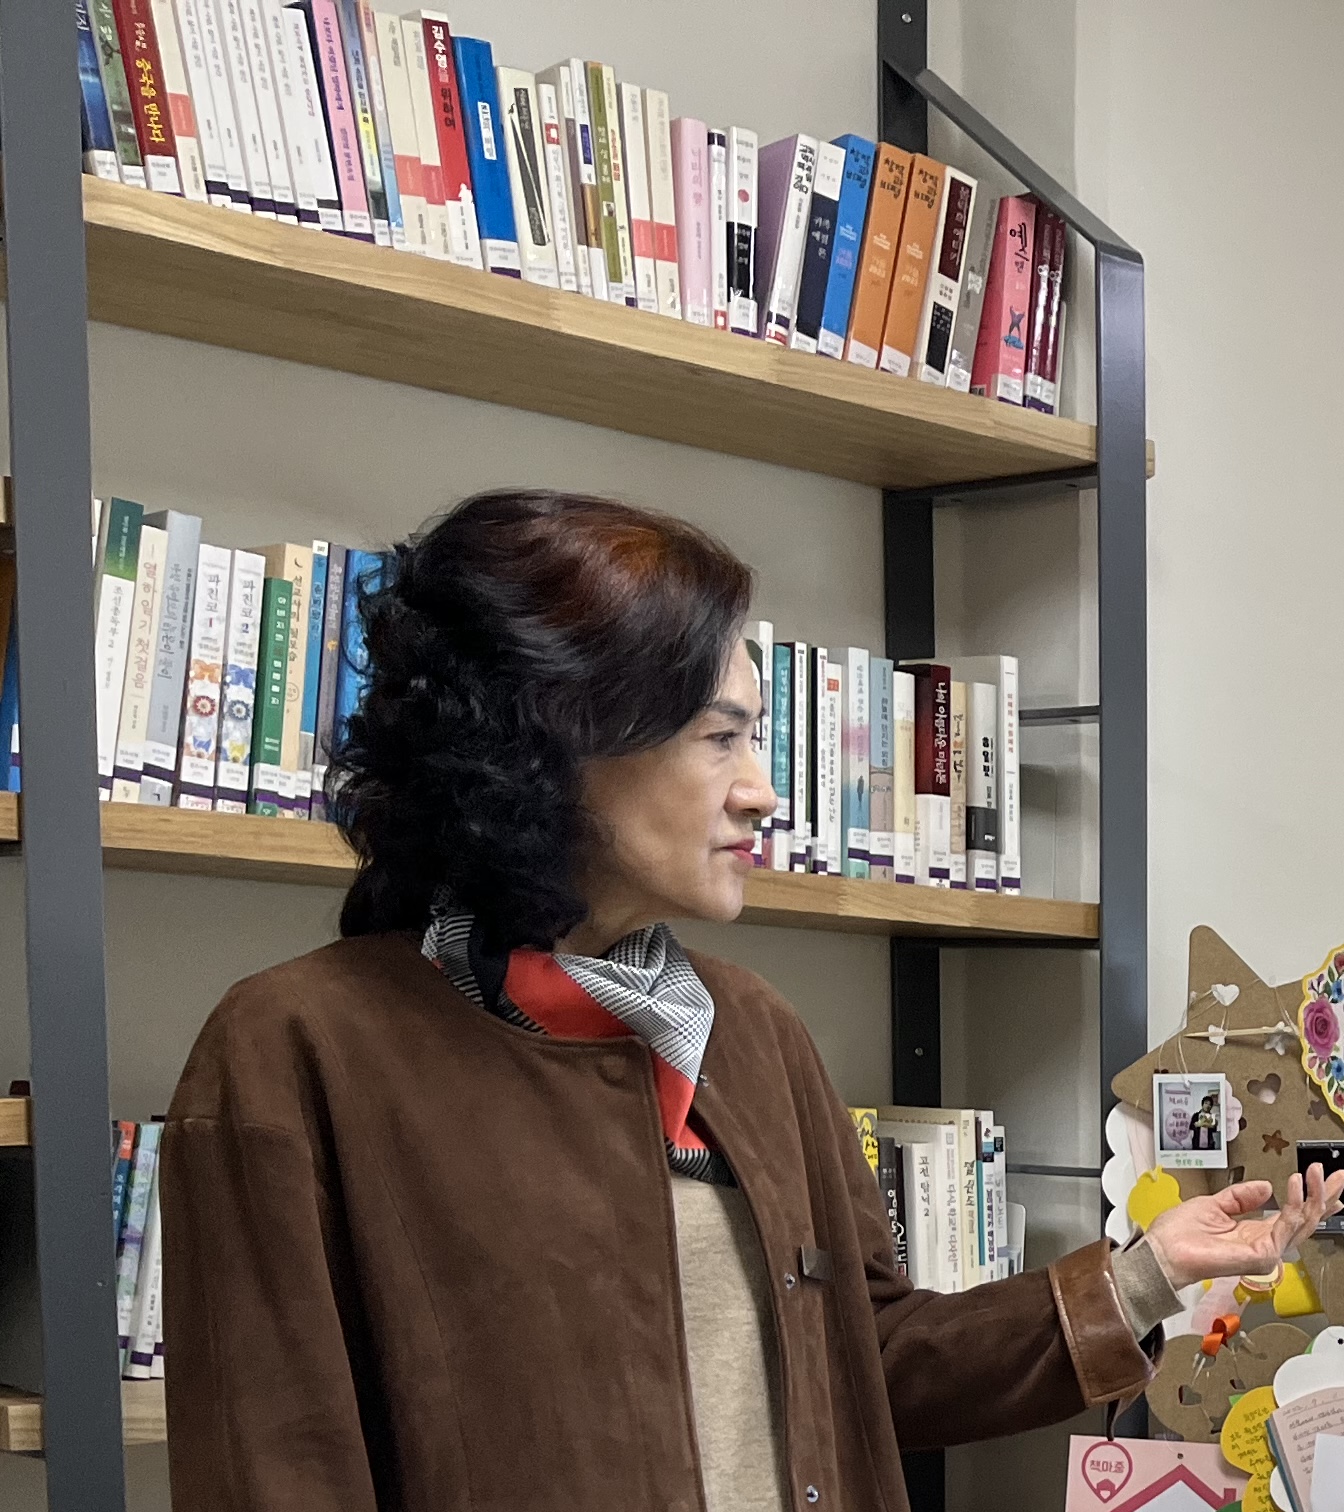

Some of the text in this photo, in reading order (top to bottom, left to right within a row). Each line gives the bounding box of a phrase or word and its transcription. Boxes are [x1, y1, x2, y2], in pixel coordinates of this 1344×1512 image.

[144, 103, 166, 143] 만나다
[207, 574, 221, 613] 파친코
[241, 579, 256, 634] 파친코 2
[934, 682, 948, 785] 나의 아름다운 마라톤
[918, 1156, 930, 1177] 고전
[1089, 1459, 1125, 1475] 책마중
